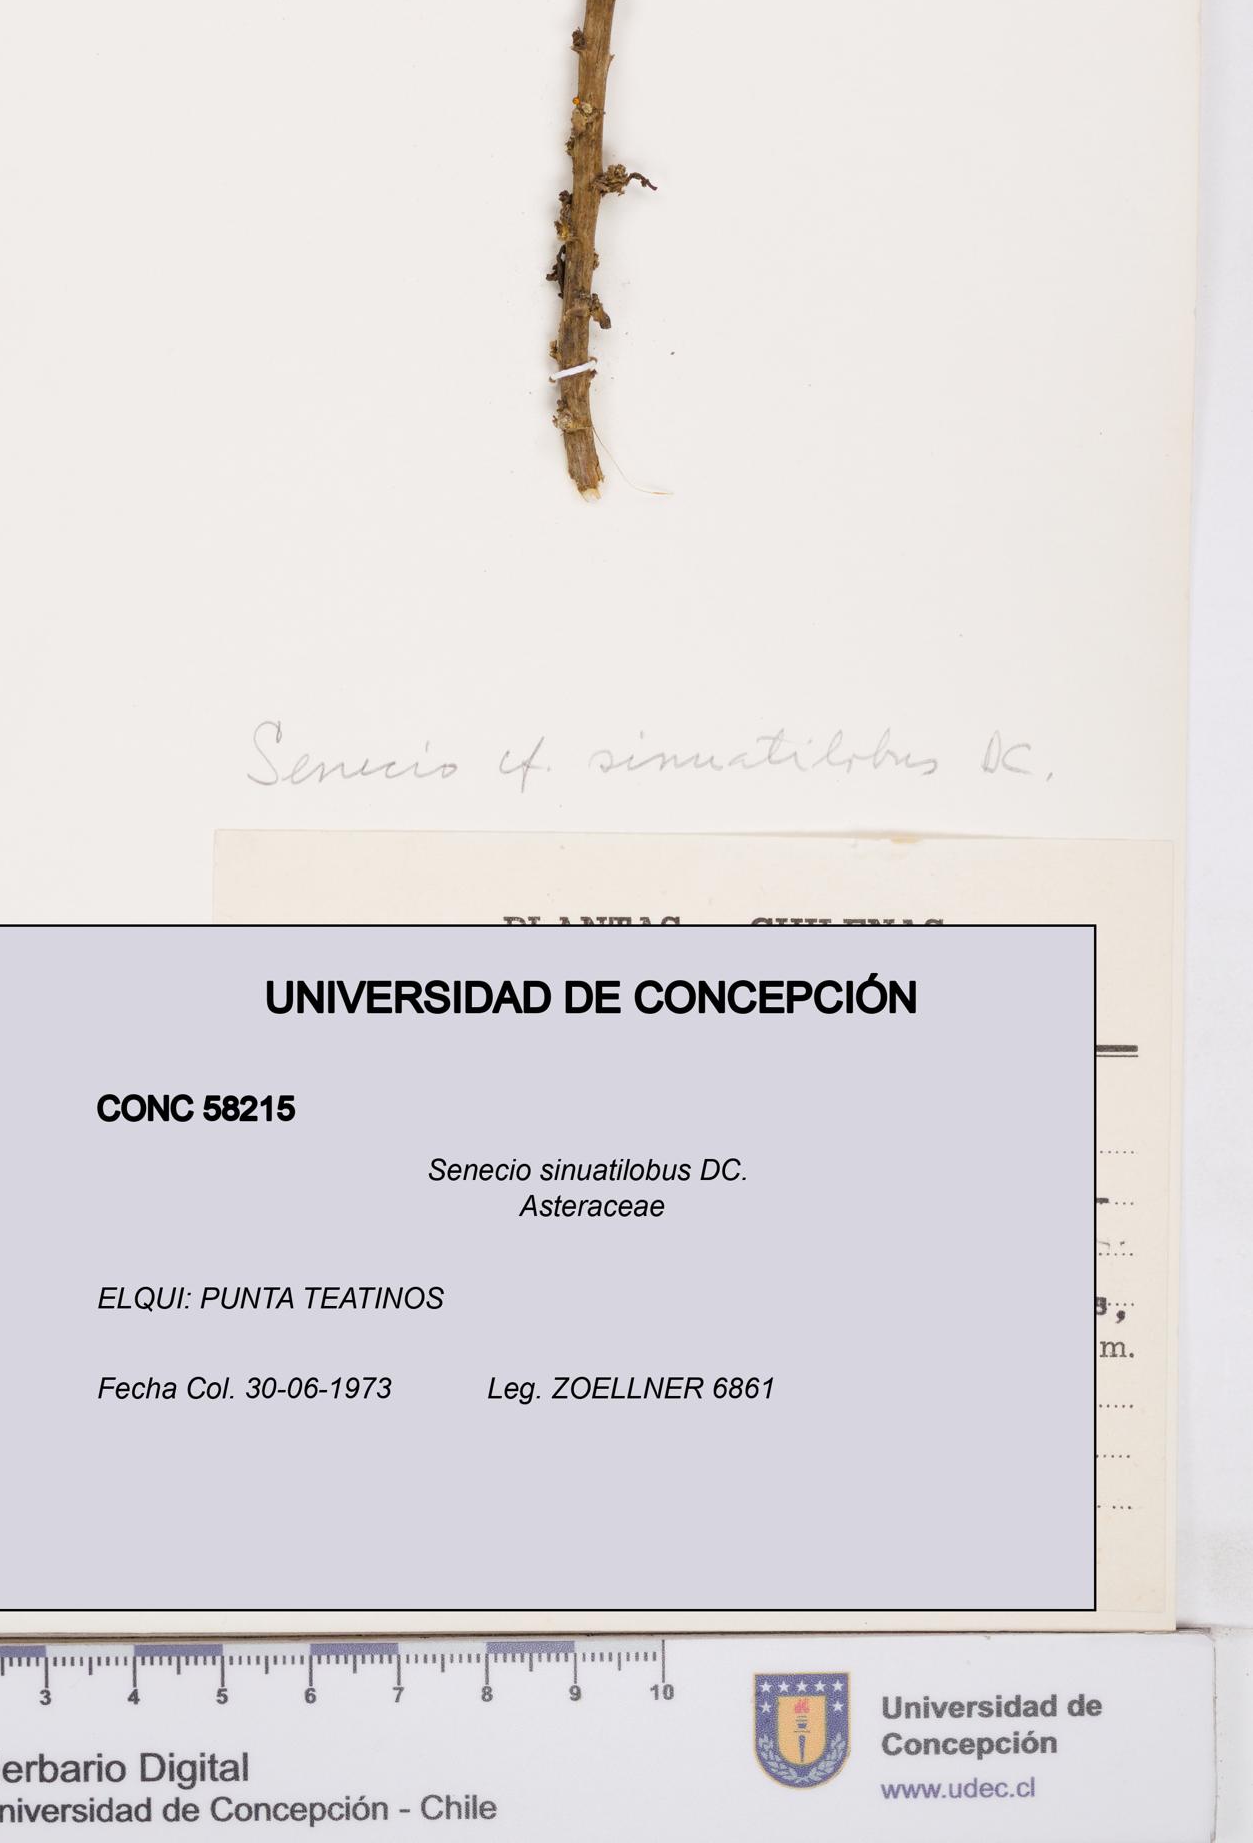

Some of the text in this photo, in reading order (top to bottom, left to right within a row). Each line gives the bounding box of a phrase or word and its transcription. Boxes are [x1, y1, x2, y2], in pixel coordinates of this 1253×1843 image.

[247, 720, 458, 786] Senecio
[39, 1689, 52, 1706] 3
[127, 1688, 141, 1705] 4
[216, 1687, 229, 1705] 5
[304, 1687, 317, 1704] 6
[392, 1686, 405, 1703] 7
[481, 1685, 494, 1703] 8
[569, 1684, 582, 1702] 9
[650, 1684, 675, 1701] 10
[882, 1693, 1103, 1720] Universidad de
[881, 1730, 1057, 1761] Concepción
[140, 1751, 249, 1791] Digital
[880, 1776, 1036, 1800] www.udec.cl
[162, 1796, 200, 1823] de
[210, 1795, 389, 1828] Concepción
[420, 1794, 498, 1821] Chile
